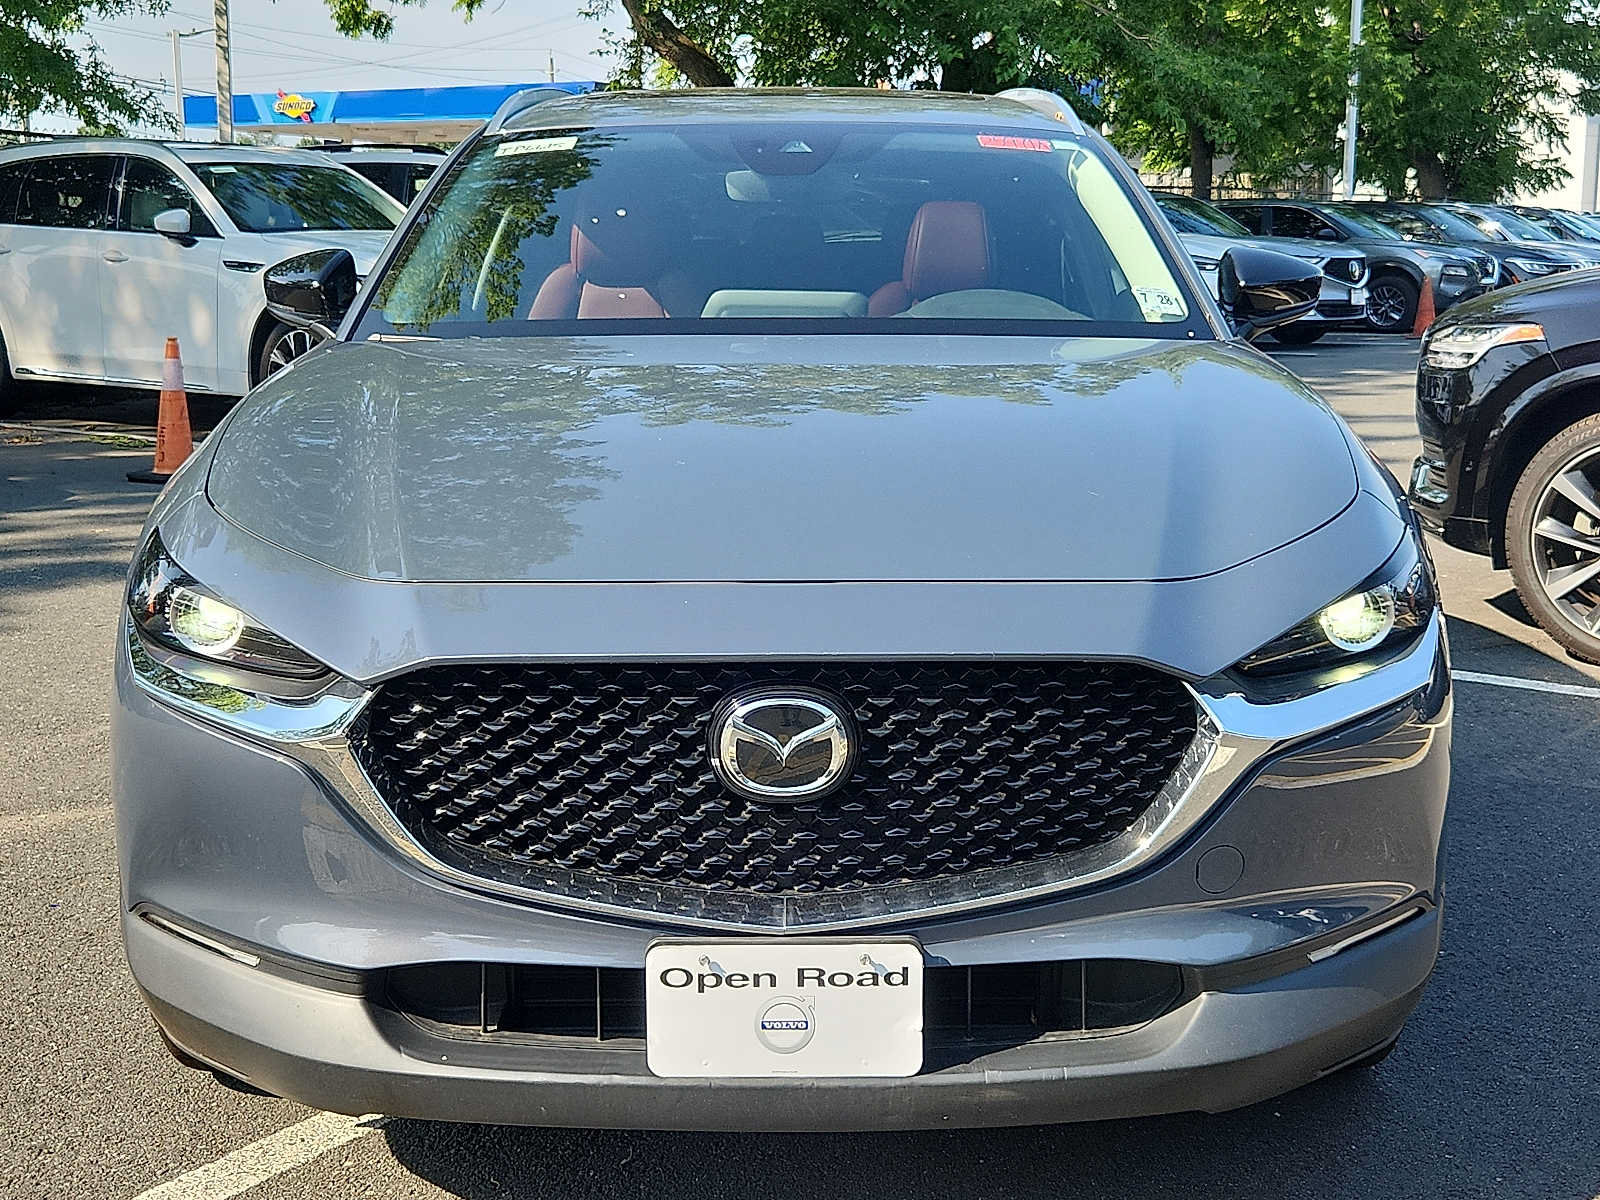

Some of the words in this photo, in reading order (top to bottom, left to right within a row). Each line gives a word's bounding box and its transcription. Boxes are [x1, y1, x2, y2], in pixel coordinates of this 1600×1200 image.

[276, 101, 312, 112] SUNOCO
[1139, 292, 1148, 303] 7
[1156, 294, 1173, 306] 28
[659, 967, 777, 994] Open
[796, 966, 909, 988] Road
[762, 1021, 807, 1030] VOLVO
